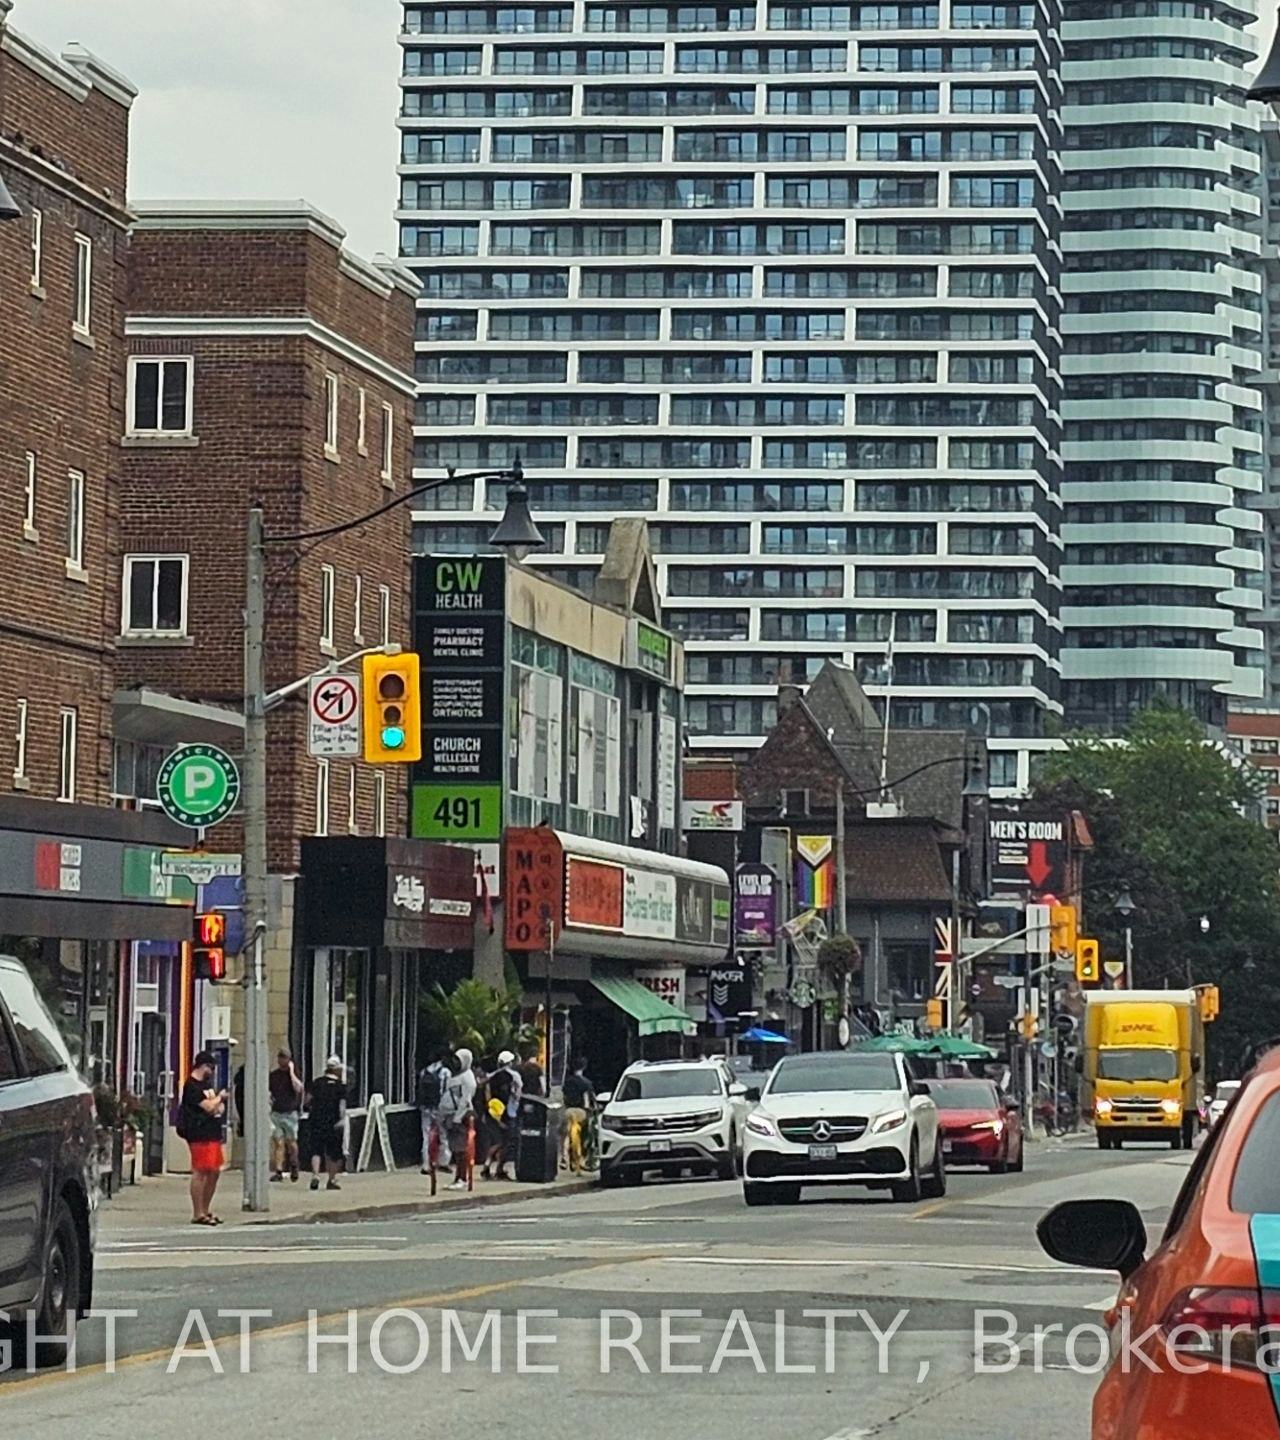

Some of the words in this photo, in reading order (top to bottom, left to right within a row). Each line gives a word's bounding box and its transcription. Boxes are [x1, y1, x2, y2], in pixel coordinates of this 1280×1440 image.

[436, 562, 483, 592] CW
[435, 594, 483, 608] HEALTH
[433, 636, 483, 646] PHARMACY
[433, 648, 459, 657] DENTAL
[461, 648, 484, 657] CLINIC
[432, 709, 483, 717] ORTHOTICS
[434, 737, 480, 751] CHURCH
[434, 753, 480, 763] WELLESLEY
[184, 765, 216, 798] P
[434, 797, 482, 830] 491
[990, 821, 1026, 840] MEN'S
[1028, 822, 1062, 840] ROOM
